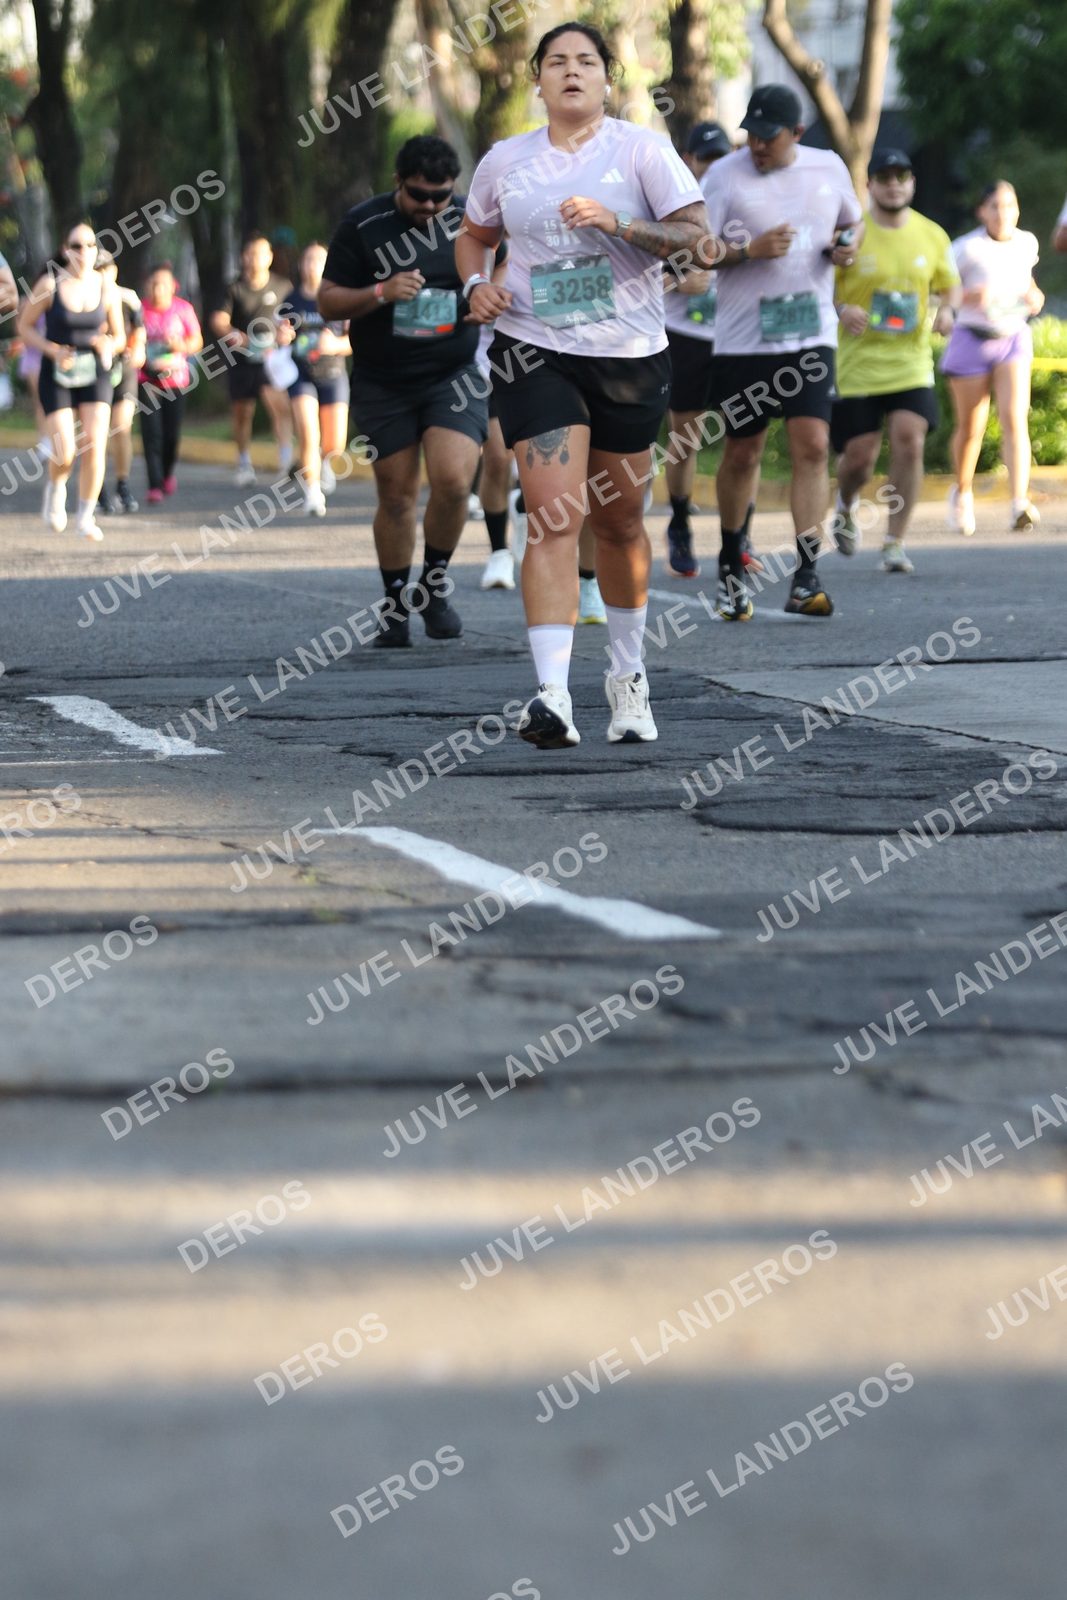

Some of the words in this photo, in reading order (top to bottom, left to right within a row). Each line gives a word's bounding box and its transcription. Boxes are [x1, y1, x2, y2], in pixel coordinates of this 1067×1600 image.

[544, 220, 557, 231] 15
[546, 234, 560, 247] 30
[551, 274, 610, 305] 3258
